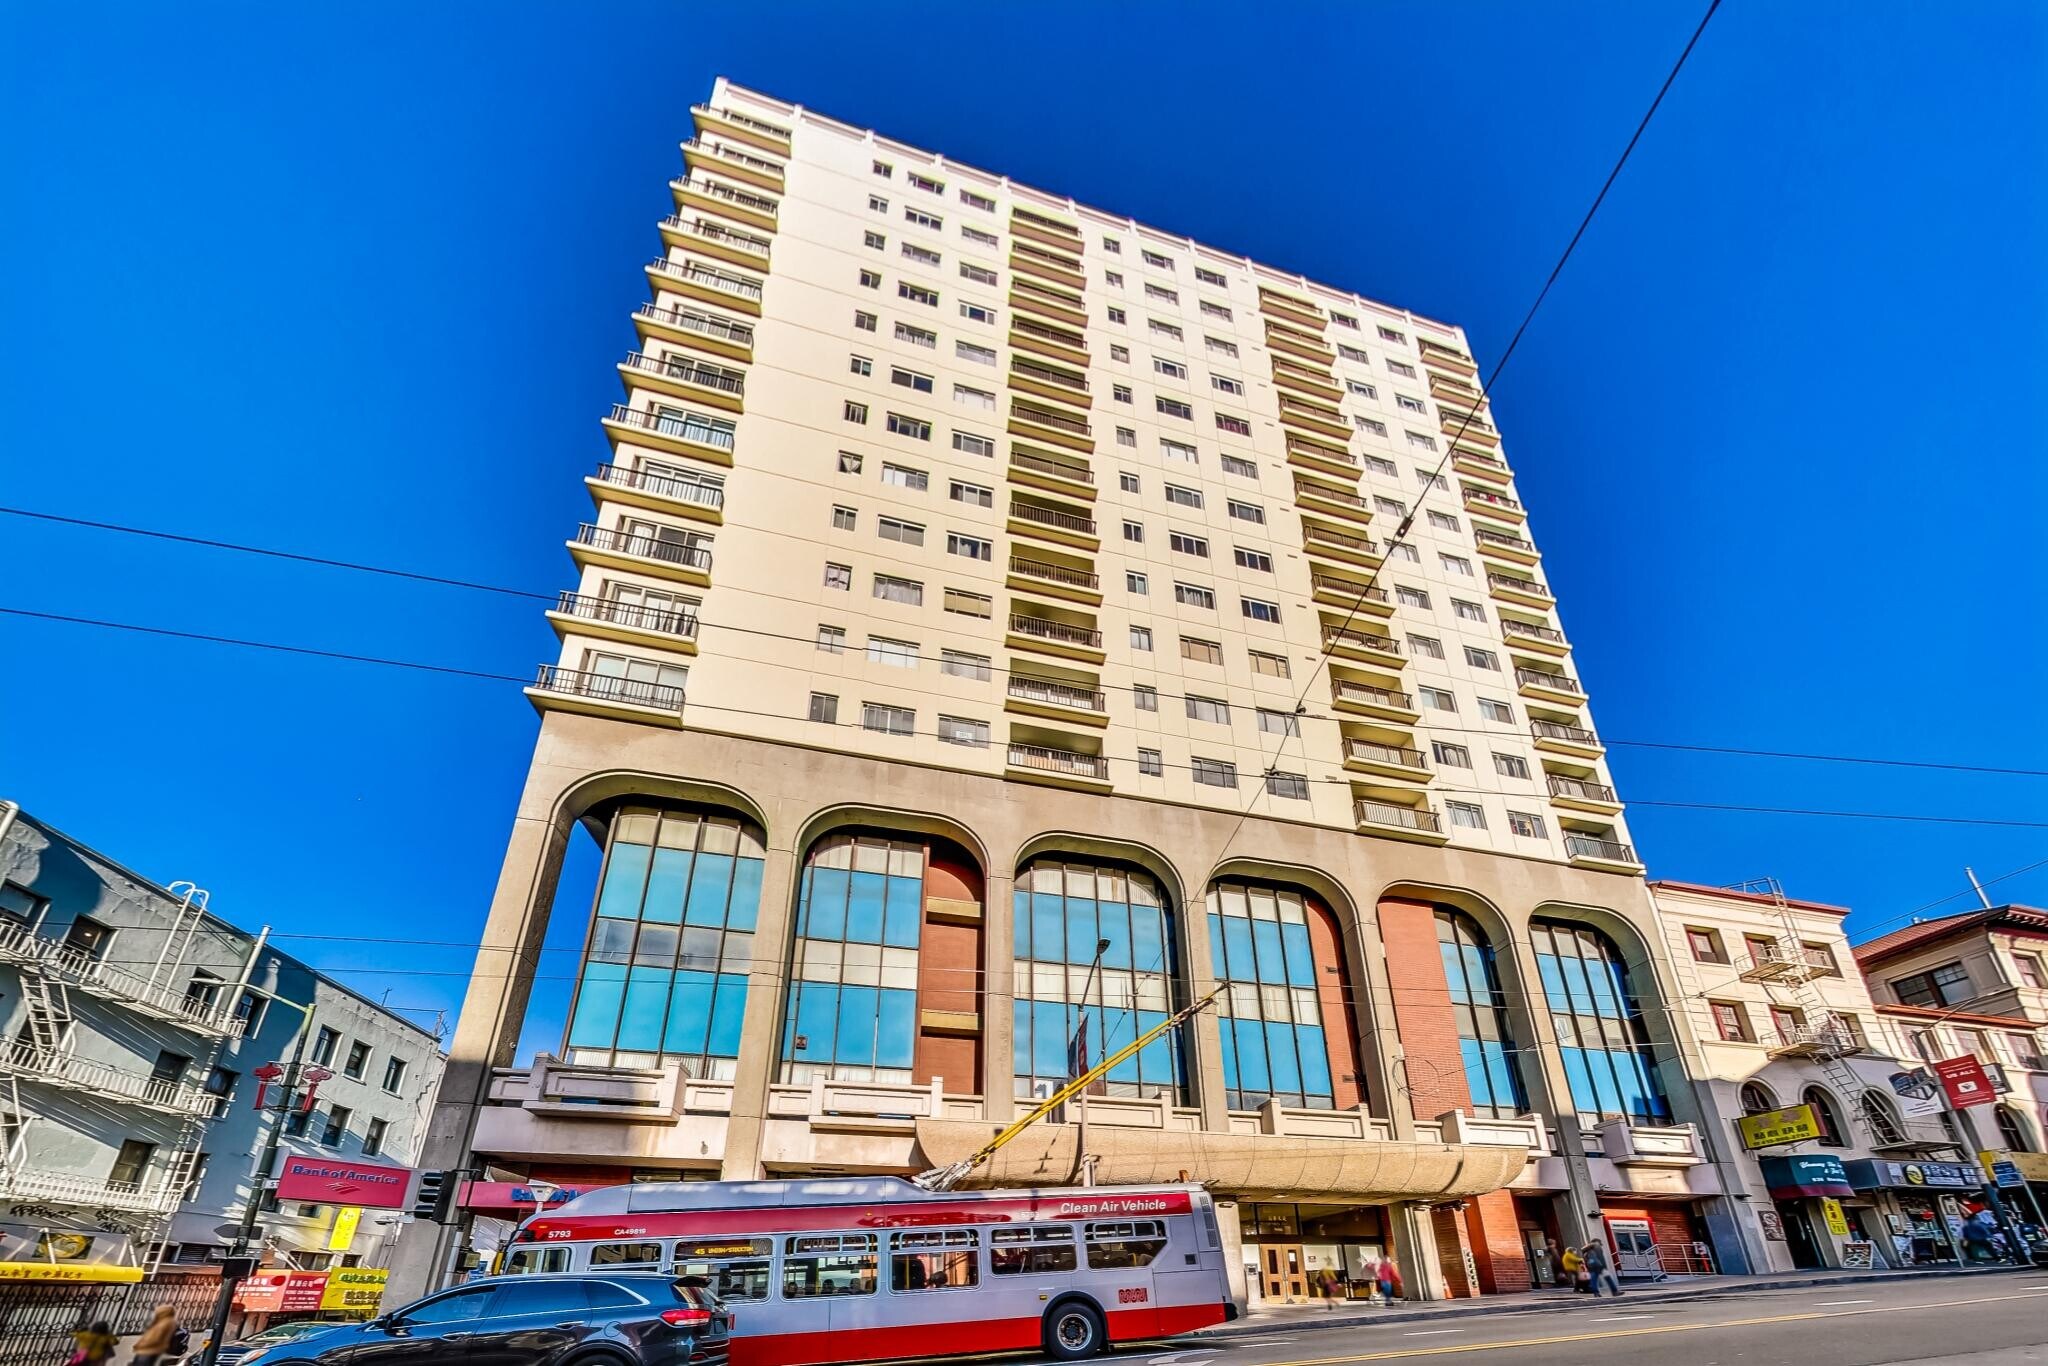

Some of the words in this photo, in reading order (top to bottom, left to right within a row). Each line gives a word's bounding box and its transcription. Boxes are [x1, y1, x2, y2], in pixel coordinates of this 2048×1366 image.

[292, 1165, 328, 1177] Bank
[329, 1170, 345, 1179] of
[345, 1171, 399, 1184] America
[1060, 1203, 1097, 1214] Clean
[1100, 1201, 1119, 1212] Air
[1120, 1199, 1167, 1211] Vehicle
[548, 1230, 572, 1239] 5793
